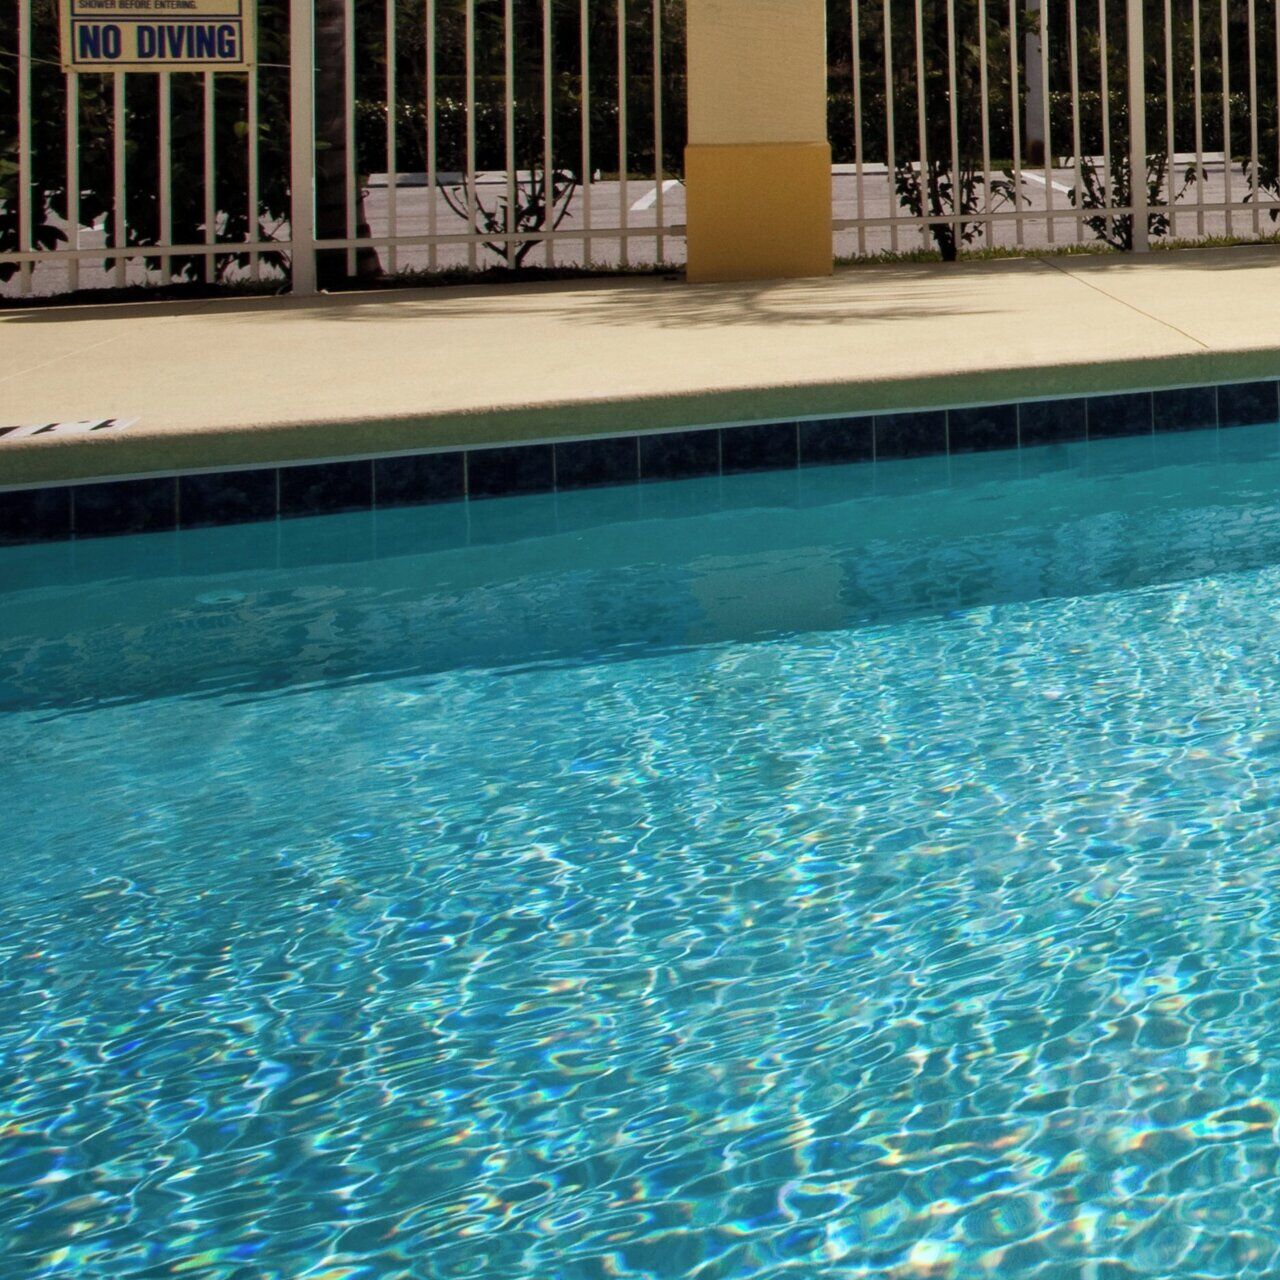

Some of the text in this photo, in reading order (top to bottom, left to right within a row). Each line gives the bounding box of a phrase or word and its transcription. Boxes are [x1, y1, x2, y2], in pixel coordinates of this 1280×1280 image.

[79, 0, 116, 9] SHOWER
[119, 0, 151, 9] BEFORE
[79, 24, 236, 59] NO DIVING
